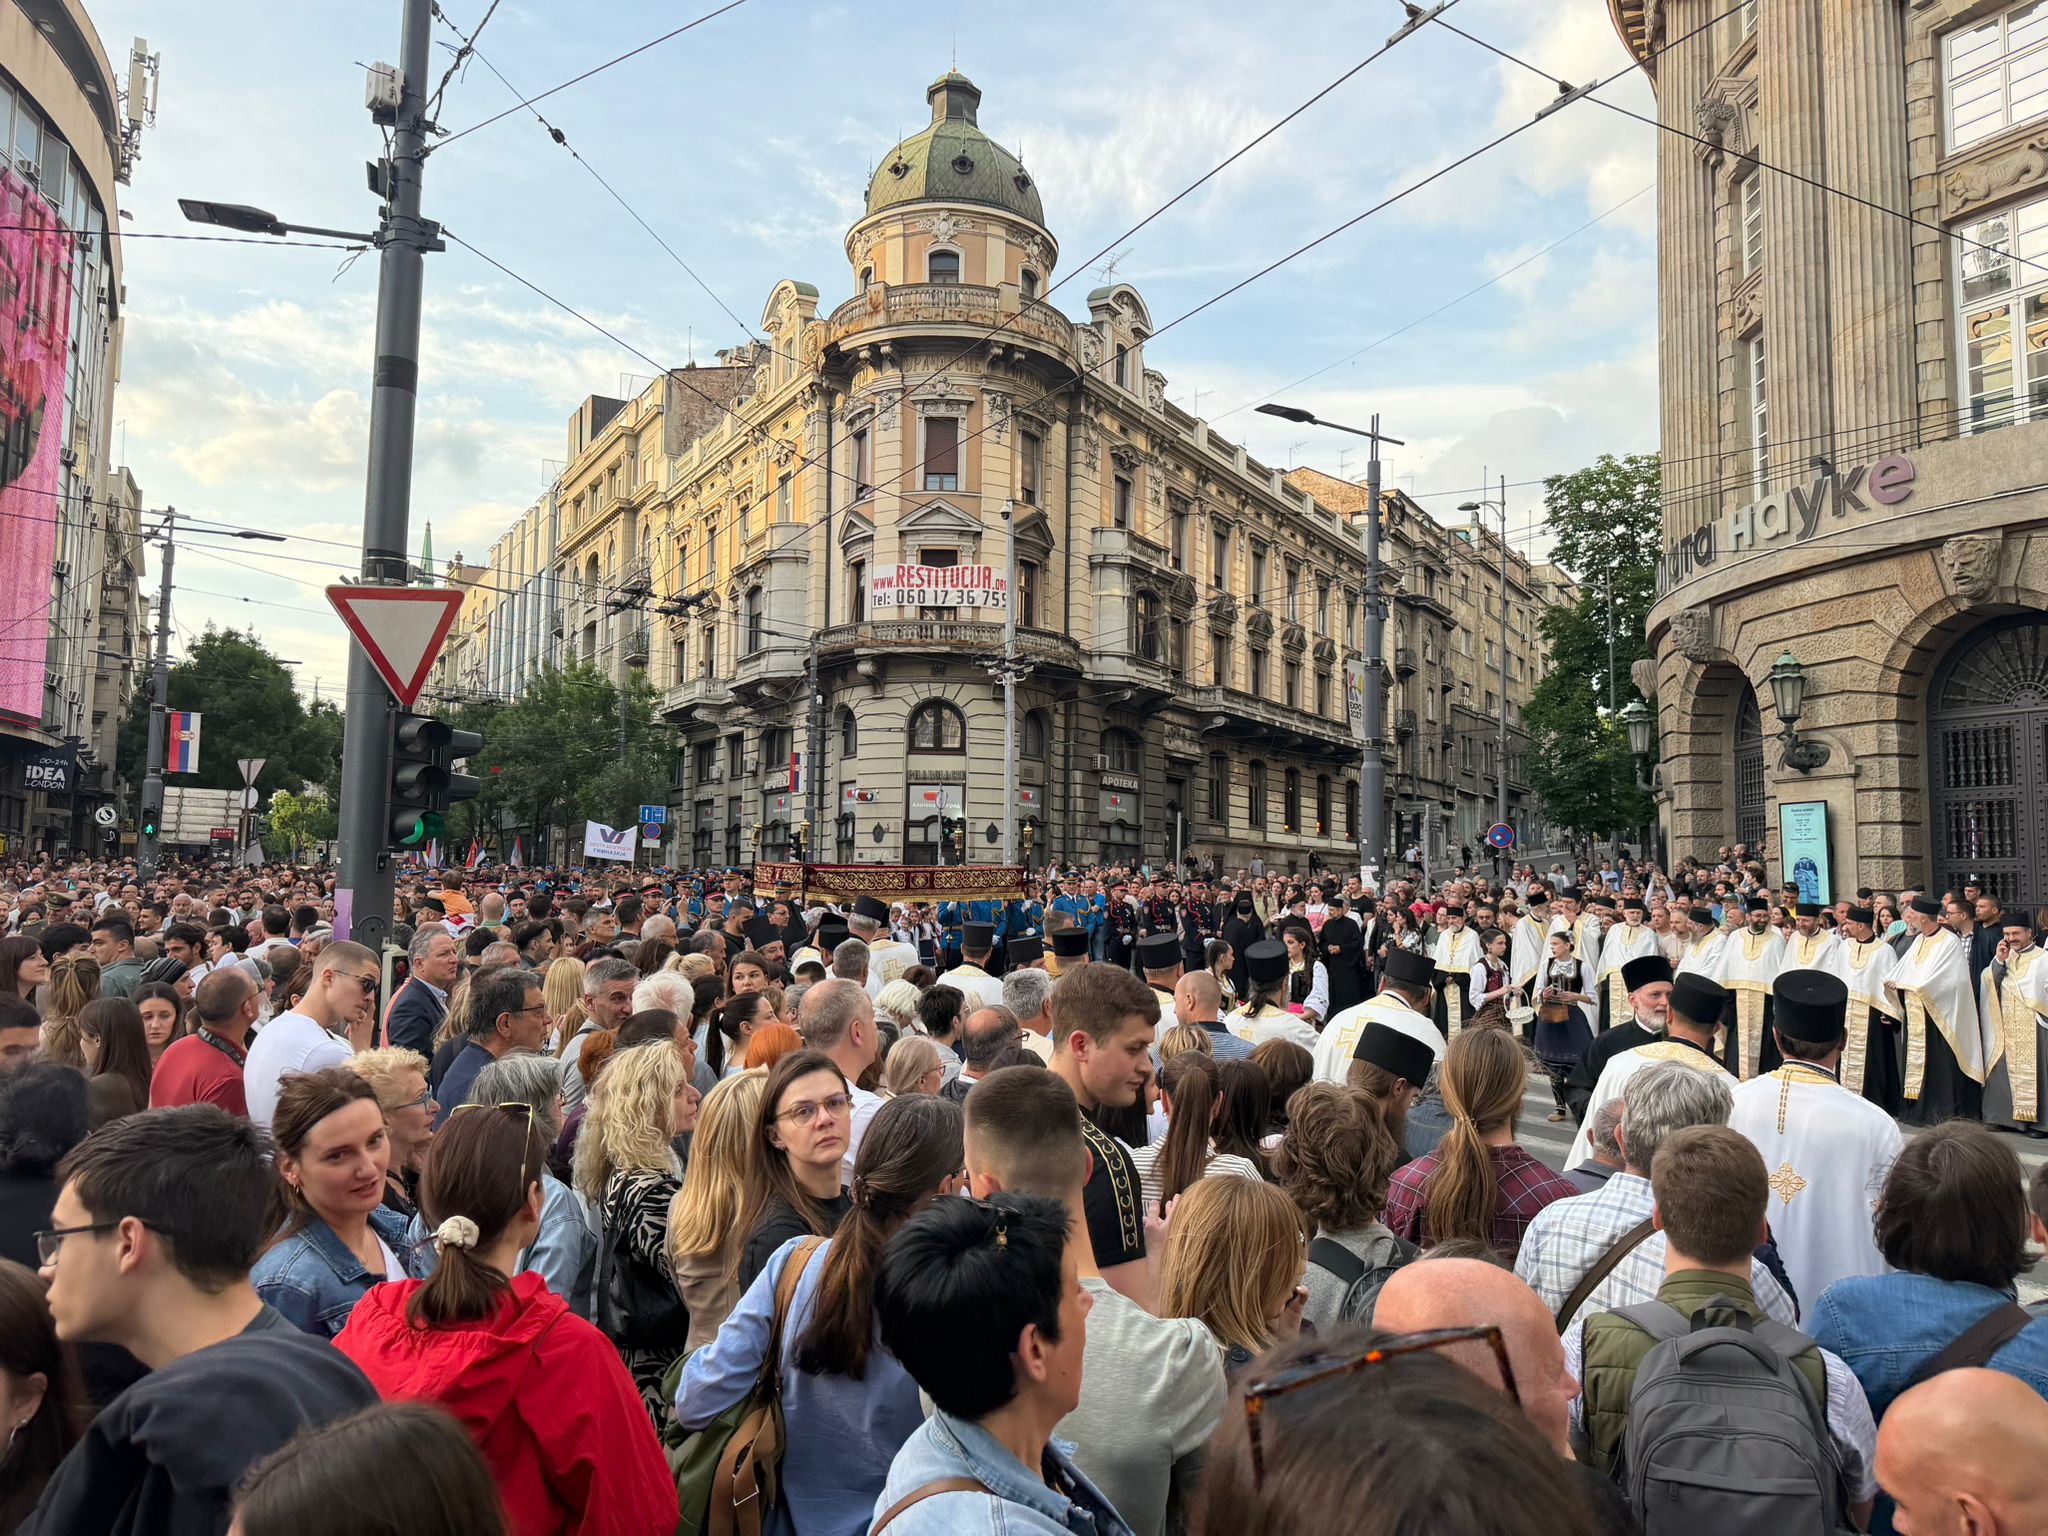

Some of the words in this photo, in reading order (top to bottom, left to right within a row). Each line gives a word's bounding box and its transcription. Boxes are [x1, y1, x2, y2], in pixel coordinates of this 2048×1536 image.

[1727, 455, 1915, 551] науке
[873, 591, 890, 606] Tel:
[896, 589, 925, 604] 060
[934, 590, 948, 604] 17
[956, 590, 974, 604] 36
[24, 779, 65, 790] LONDON
[1102, 775, 1138, 790] APOTEKA
